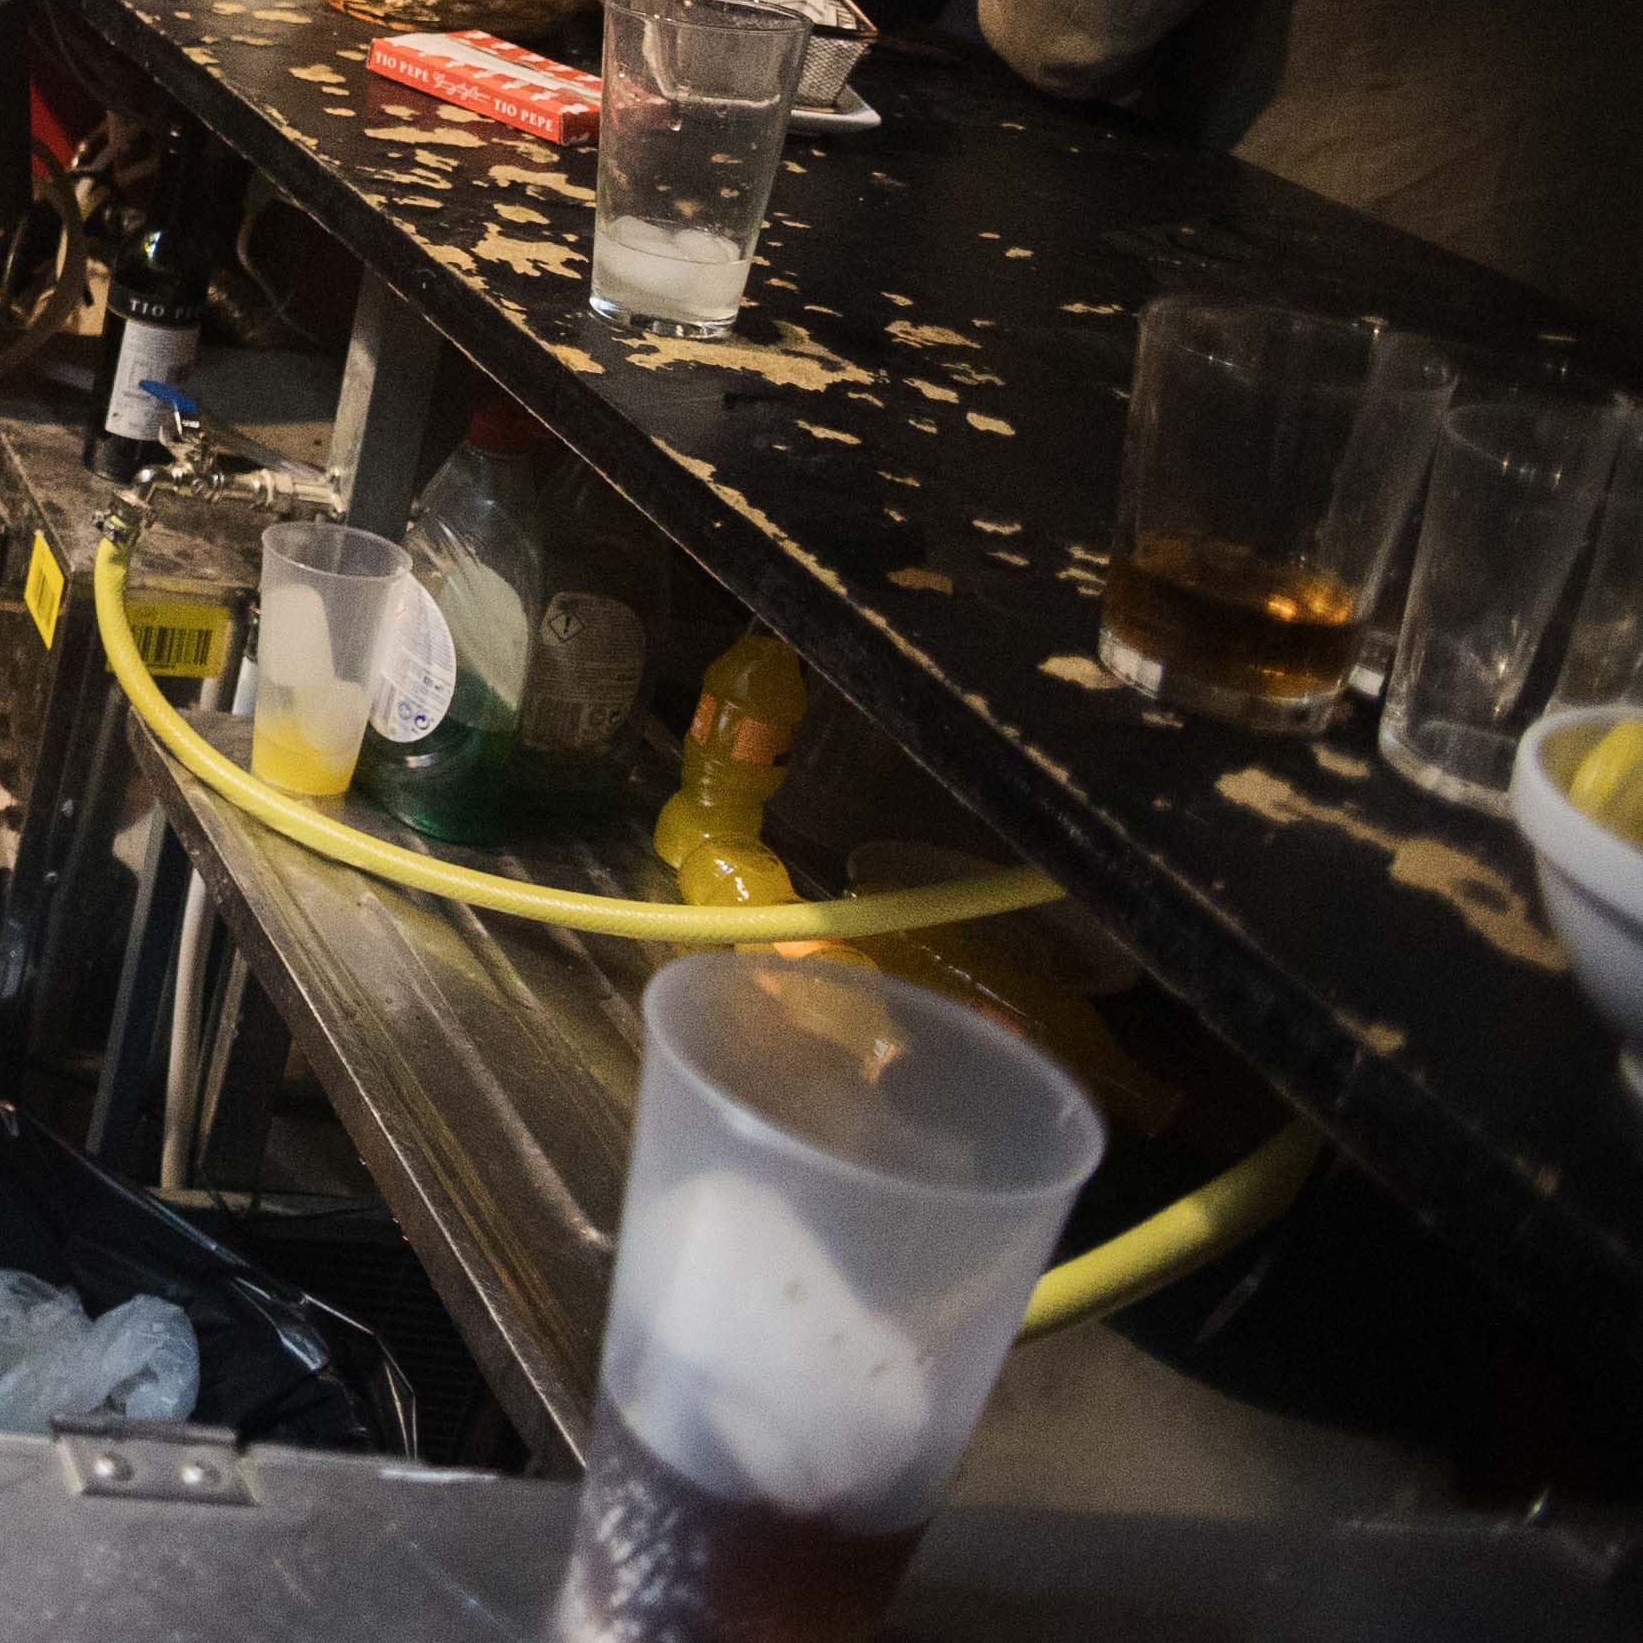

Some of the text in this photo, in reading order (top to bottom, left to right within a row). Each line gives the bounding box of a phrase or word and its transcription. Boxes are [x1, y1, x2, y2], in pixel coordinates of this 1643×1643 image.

[374, 51, 431, 83] TIO PEPE
[493, 98, 554, 133] TIO PEPE
[129, 297, 166, 318] TIO
